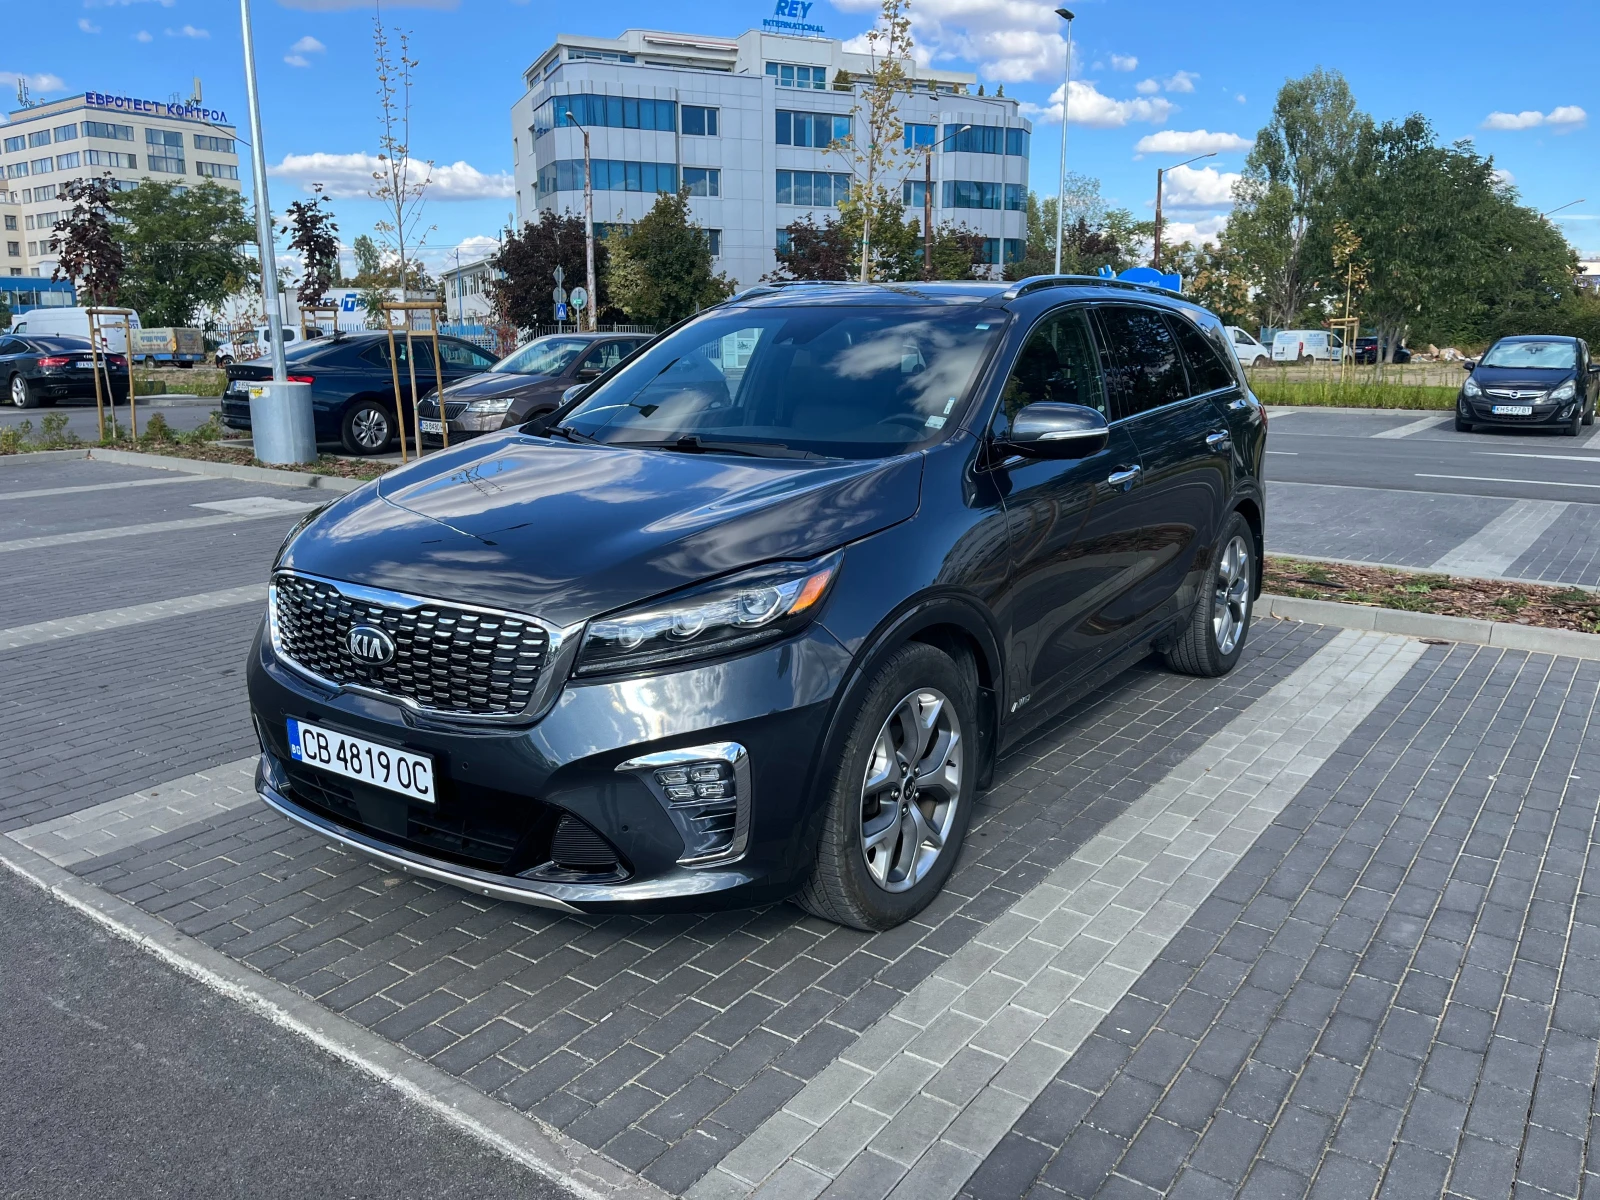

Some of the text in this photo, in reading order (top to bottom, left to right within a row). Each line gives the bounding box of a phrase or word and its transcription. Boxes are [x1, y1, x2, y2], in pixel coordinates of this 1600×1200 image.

[776, 0, 813, 18] REY
[763, 19, 825, 32] INTERNATIONAL
[85, 92, 227, 122] ЕВРОТЕСТ КОНТРОЛ
[350, 633, 384, 660] KIA
[291, 744, 301, 756] BG
